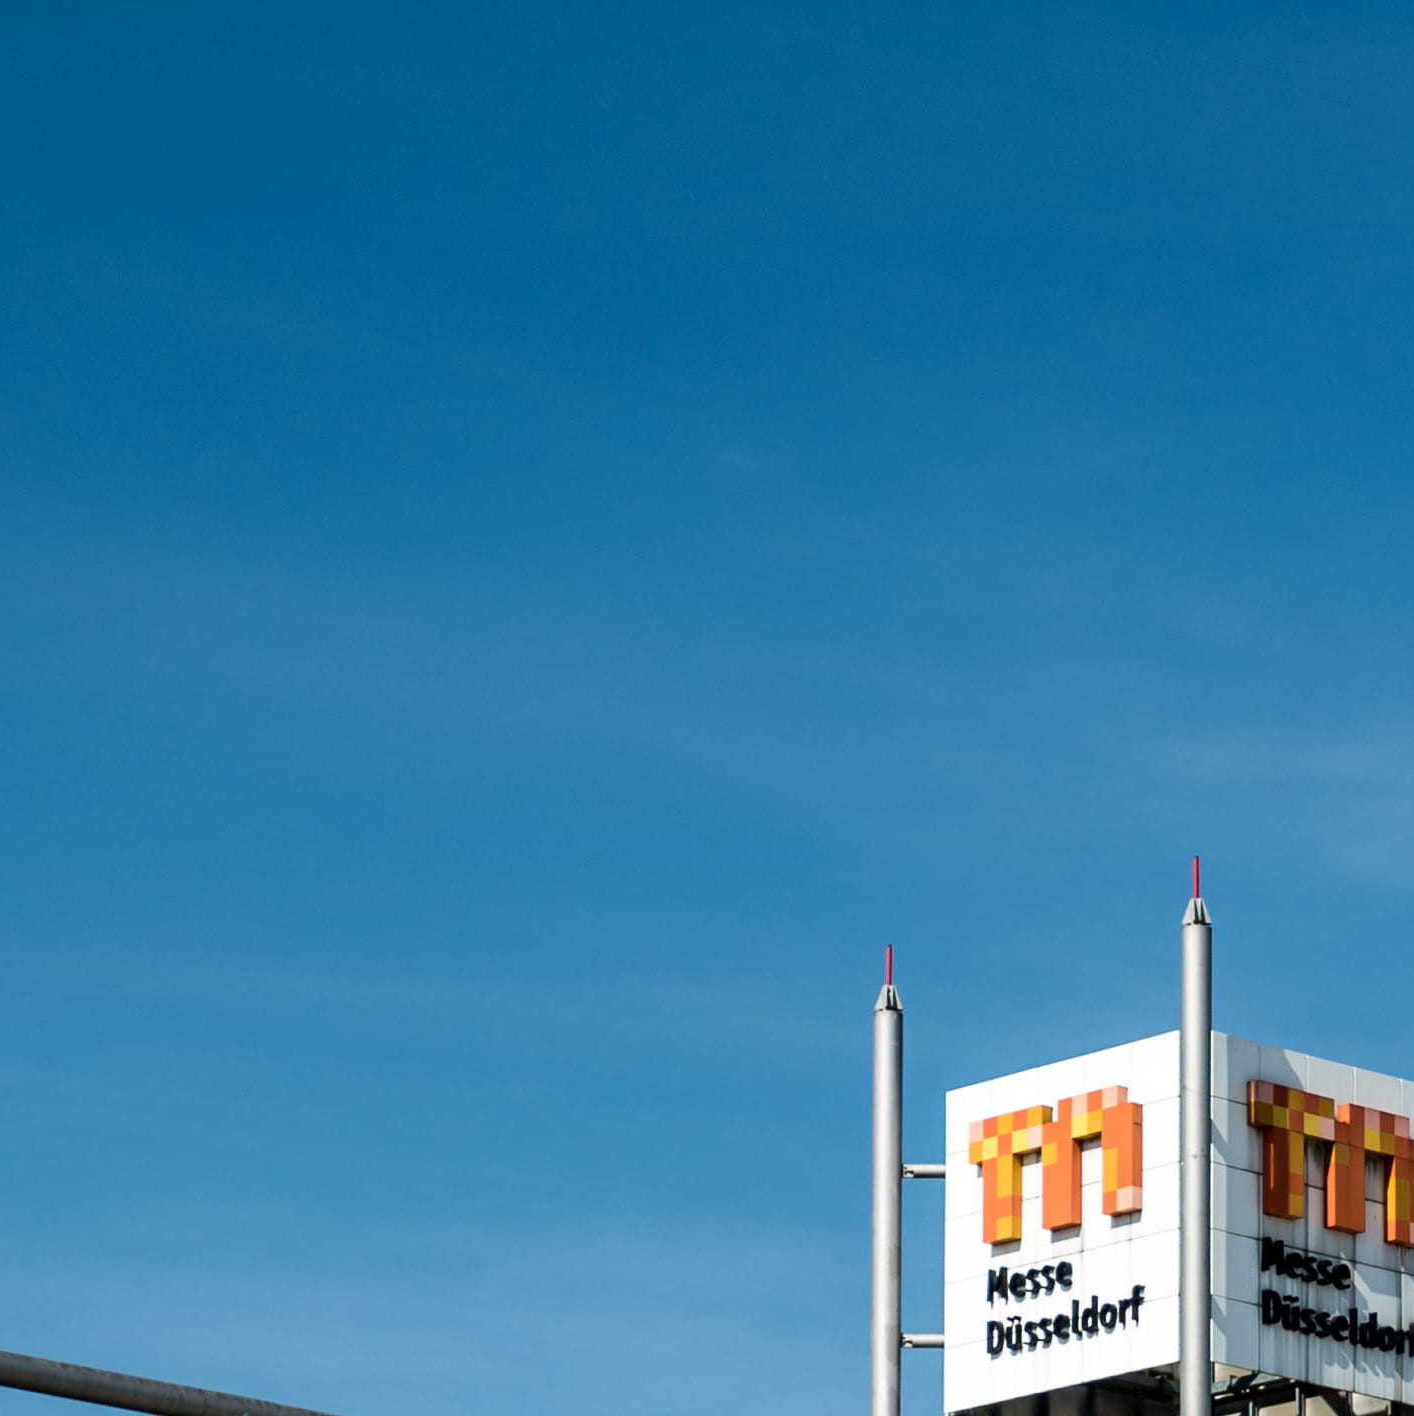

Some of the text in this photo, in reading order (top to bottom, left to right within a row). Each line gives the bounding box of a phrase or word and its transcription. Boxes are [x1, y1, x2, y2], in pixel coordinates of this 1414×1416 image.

[987, 1261, 1073, 1305] Messe
[1261, 1236, 1351, 1290] Messe
[987, 1284, 1145, 1357] Düsseldorf
